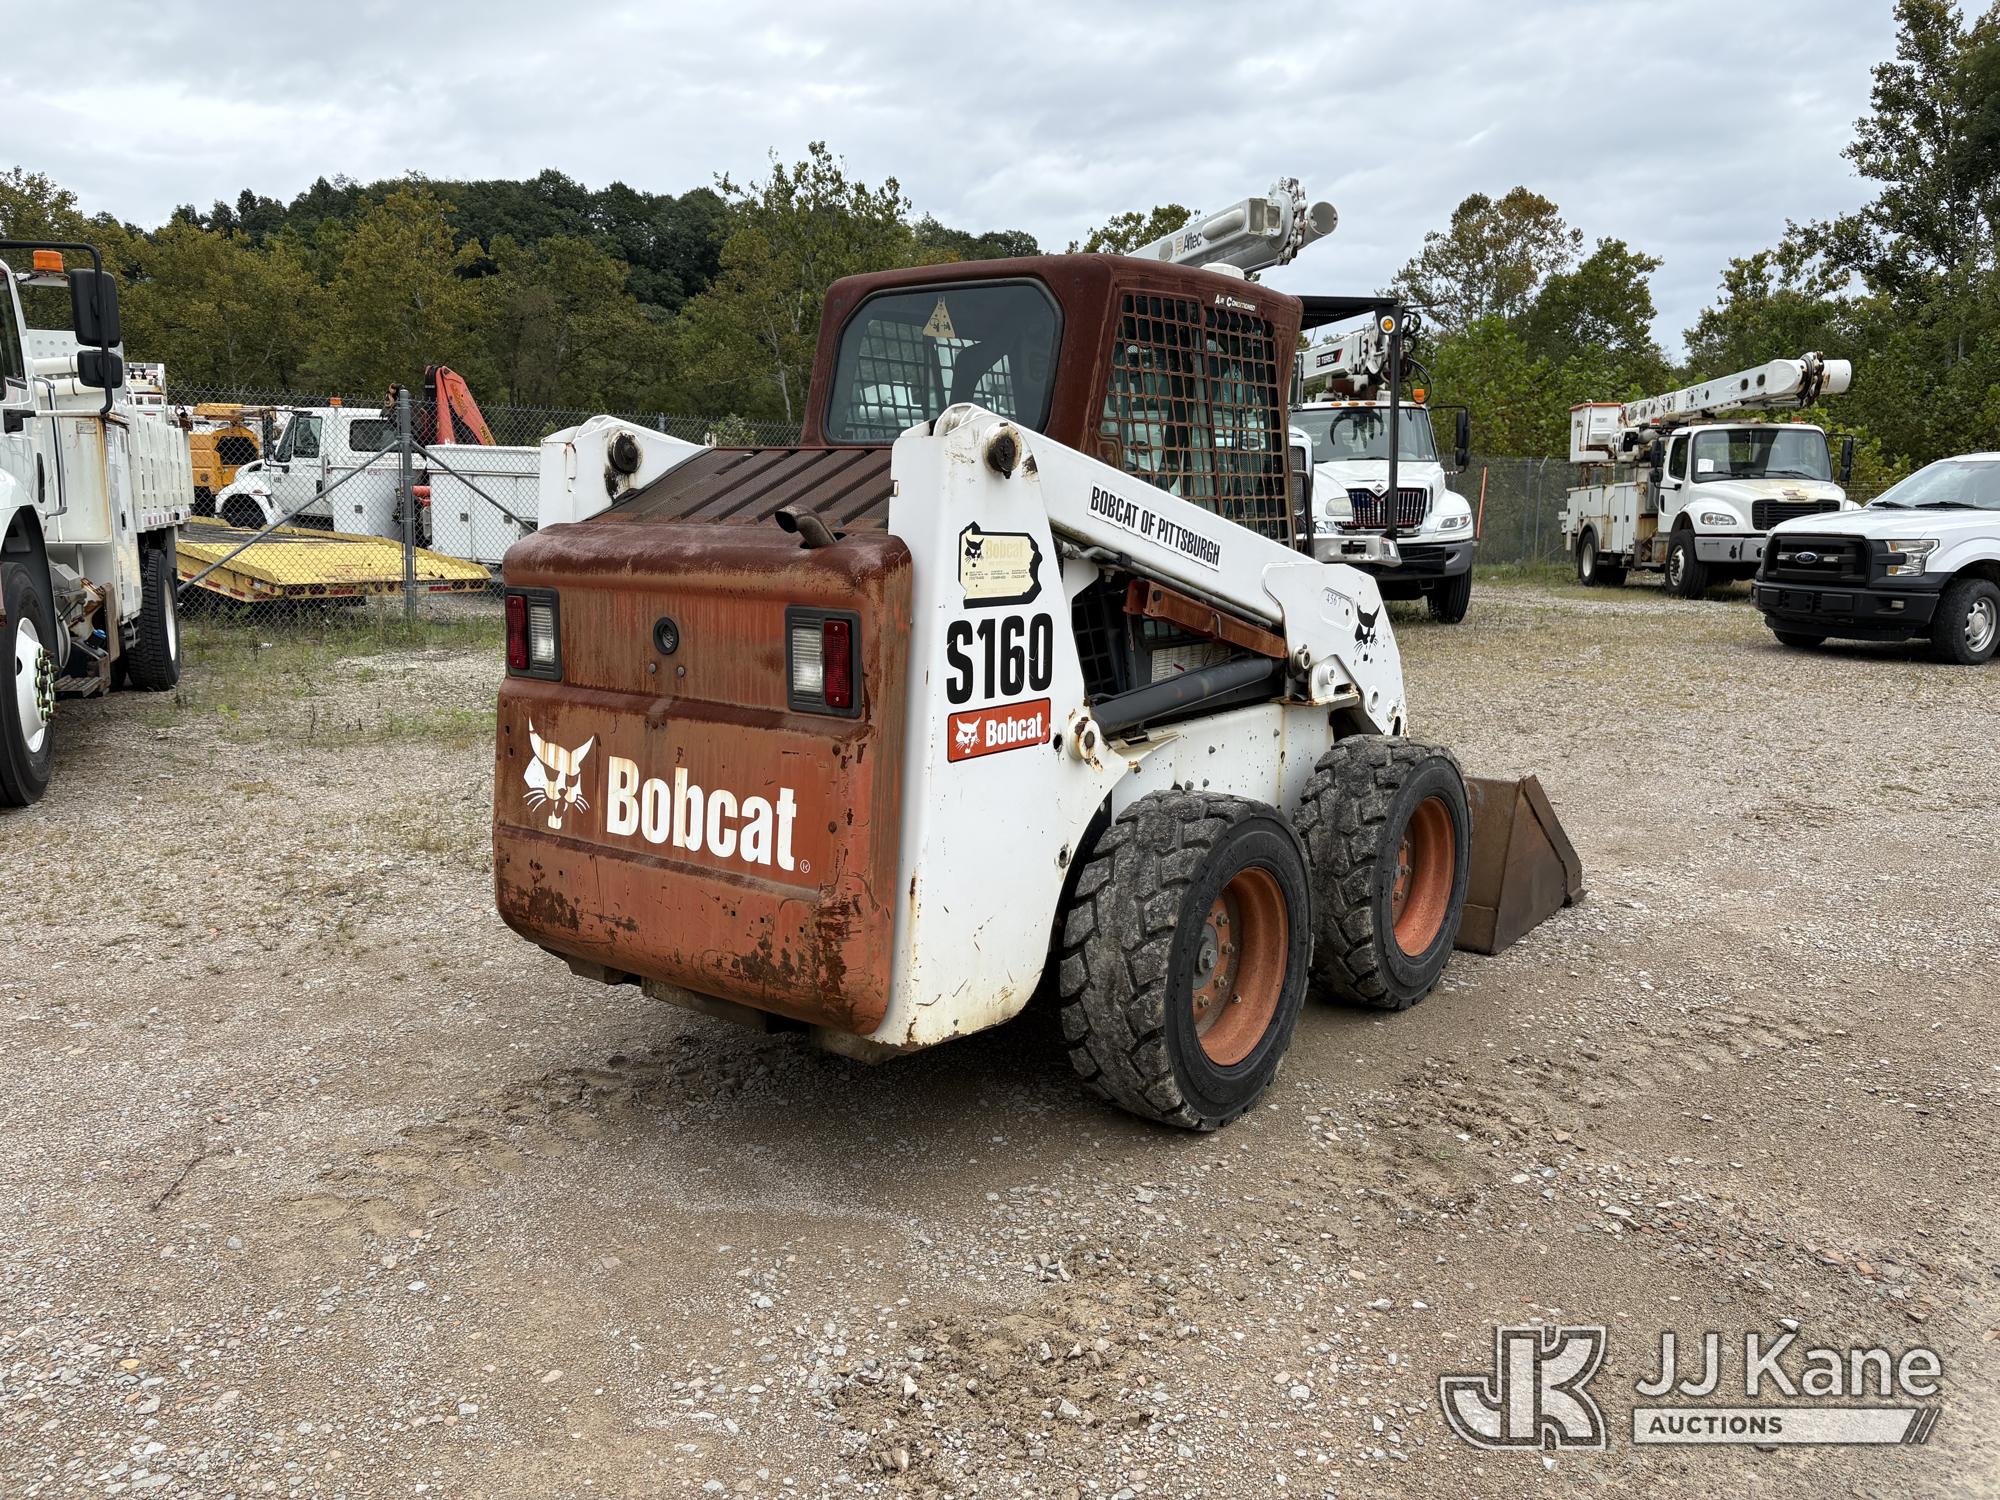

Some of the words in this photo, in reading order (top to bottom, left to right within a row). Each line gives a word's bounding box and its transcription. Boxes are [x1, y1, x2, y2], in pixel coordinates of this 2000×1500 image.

[985, 540, 1023, 560] Bobcat
[1091, 486, 1139, 529] BOBCAT
[1140, 509, 1156, 536] OF
[1157, 517, 1220, 566] PITTSBURGH
[946, 612, 1054, 705] S160
[985, 712, 1043, 748] Bobcat
[606, 755, 797, 871] Bobcat
